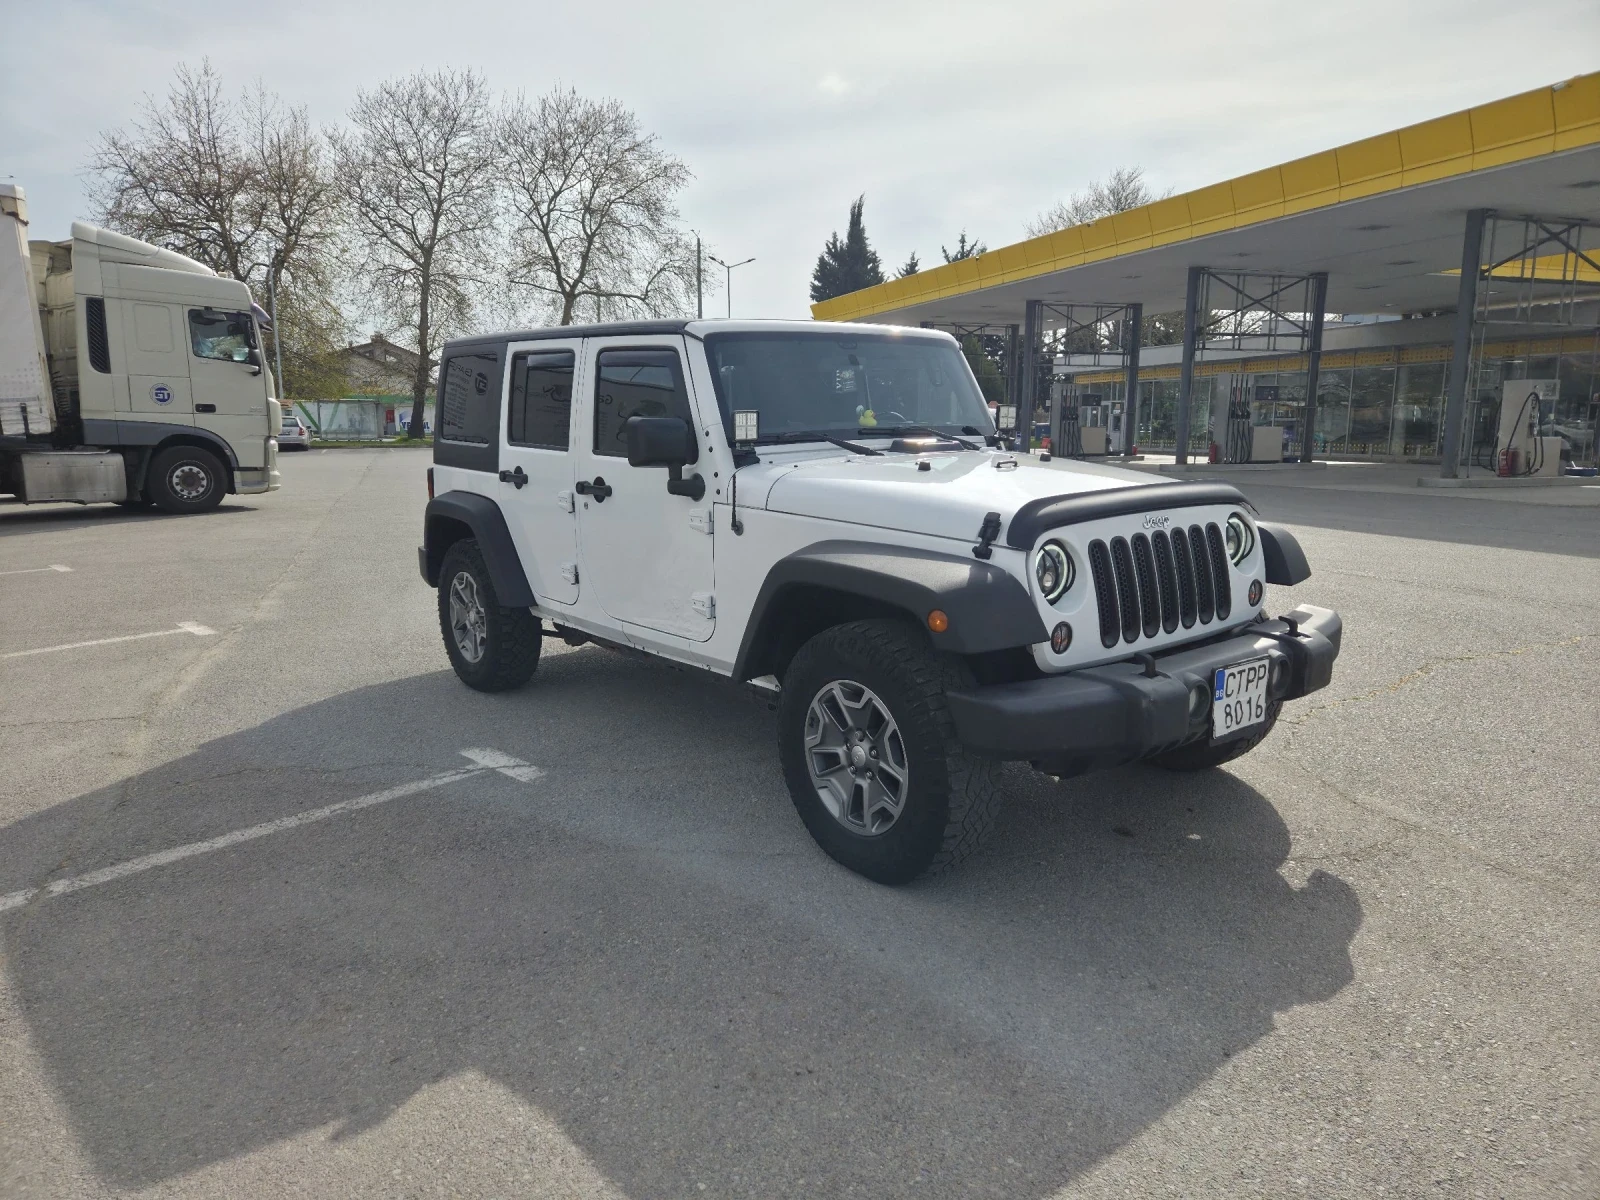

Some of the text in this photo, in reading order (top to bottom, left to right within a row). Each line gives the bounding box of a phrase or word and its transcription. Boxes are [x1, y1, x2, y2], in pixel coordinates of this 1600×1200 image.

[1142, 514, 1170, 530] Jeep
[1215, 689, 1224, 698] BG
[1225, 664, 1266, 698] CTPP
[1224, 694, 1263, 729] 8016
